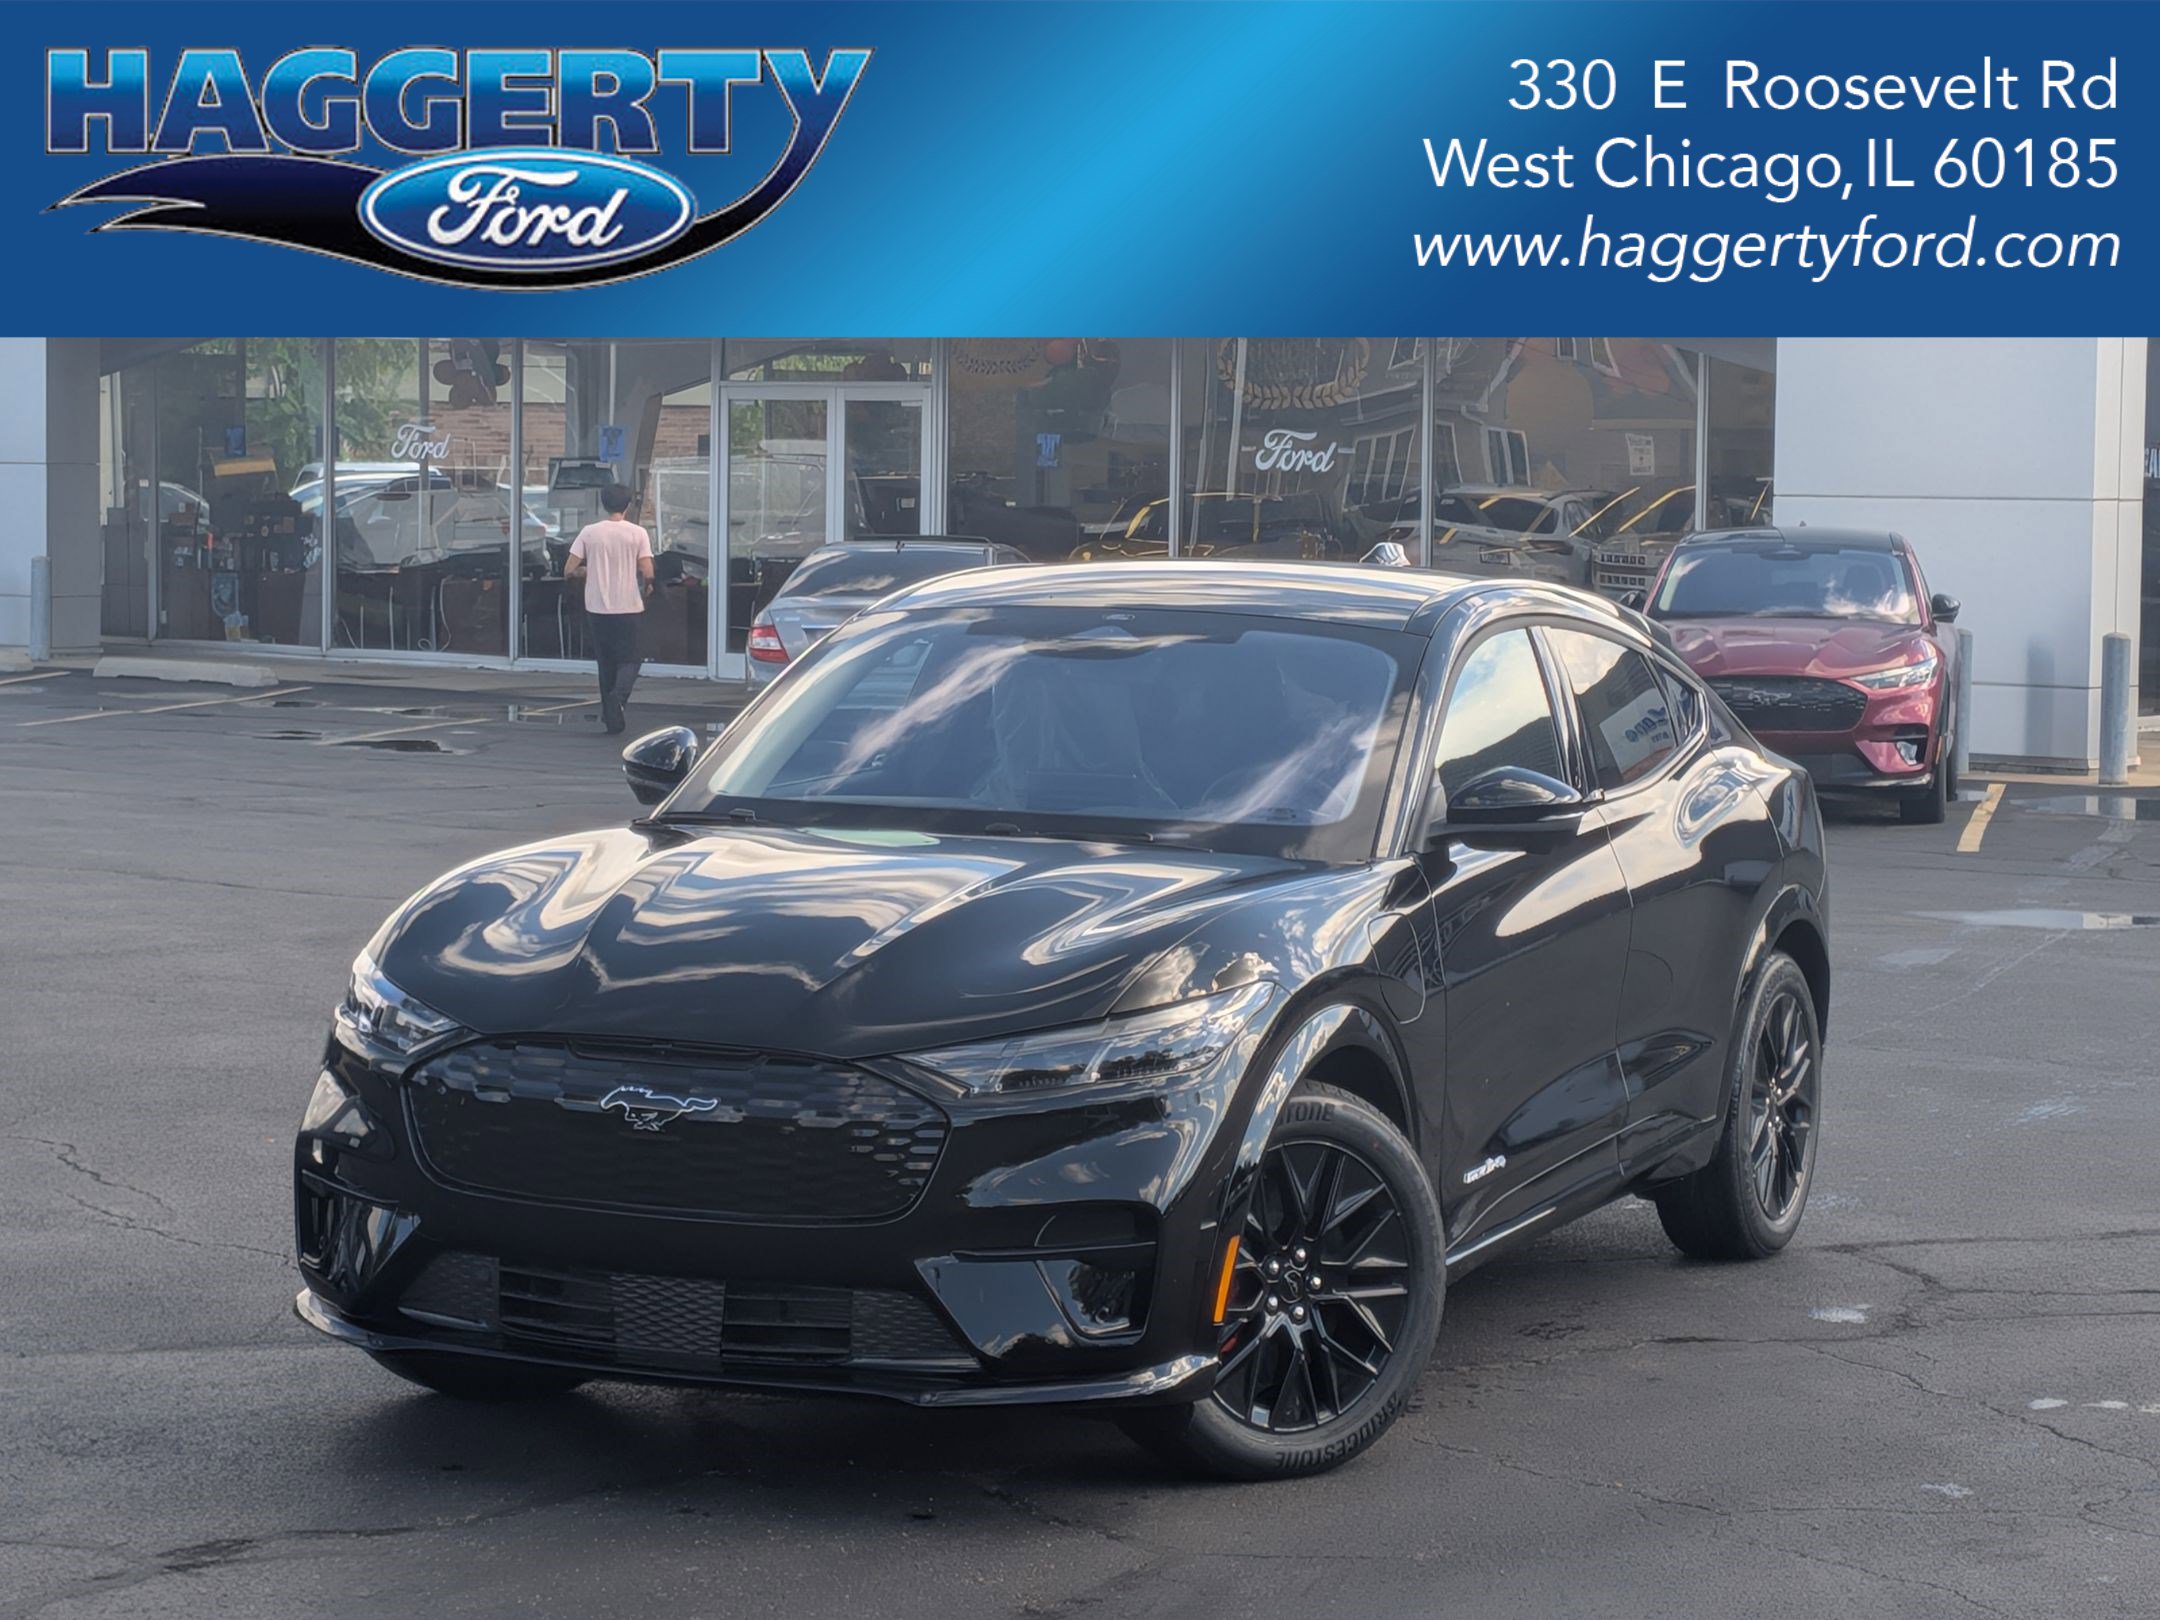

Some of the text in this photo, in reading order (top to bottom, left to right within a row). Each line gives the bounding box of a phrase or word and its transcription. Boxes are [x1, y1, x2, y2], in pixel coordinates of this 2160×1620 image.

[391, 423, 451, 460] Ford
[1255, 428, 1337, 473] Ford
[1275, 1391, 1402, 1469] BRIDGESTONE
